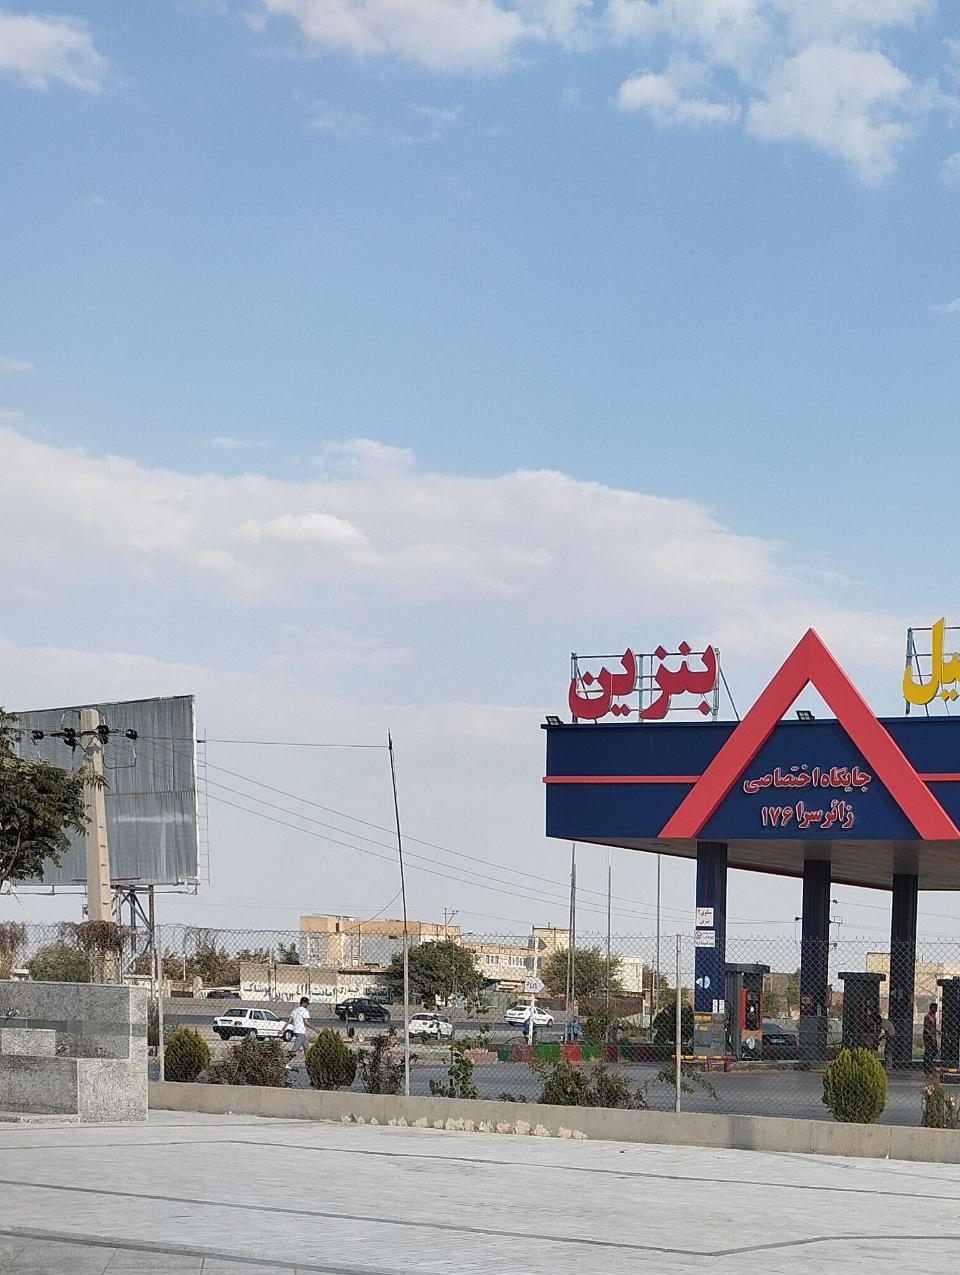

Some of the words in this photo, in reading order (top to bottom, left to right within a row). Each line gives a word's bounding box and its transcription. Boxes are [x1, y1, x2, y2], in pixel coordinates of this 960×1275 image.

[568, 640, 717, 720] بنزین
[743, 764, 819, 794] اختصاصی
[820, 765, 872, 793] جایگاه
[761, 805, 793, 827] ۱۷۶
